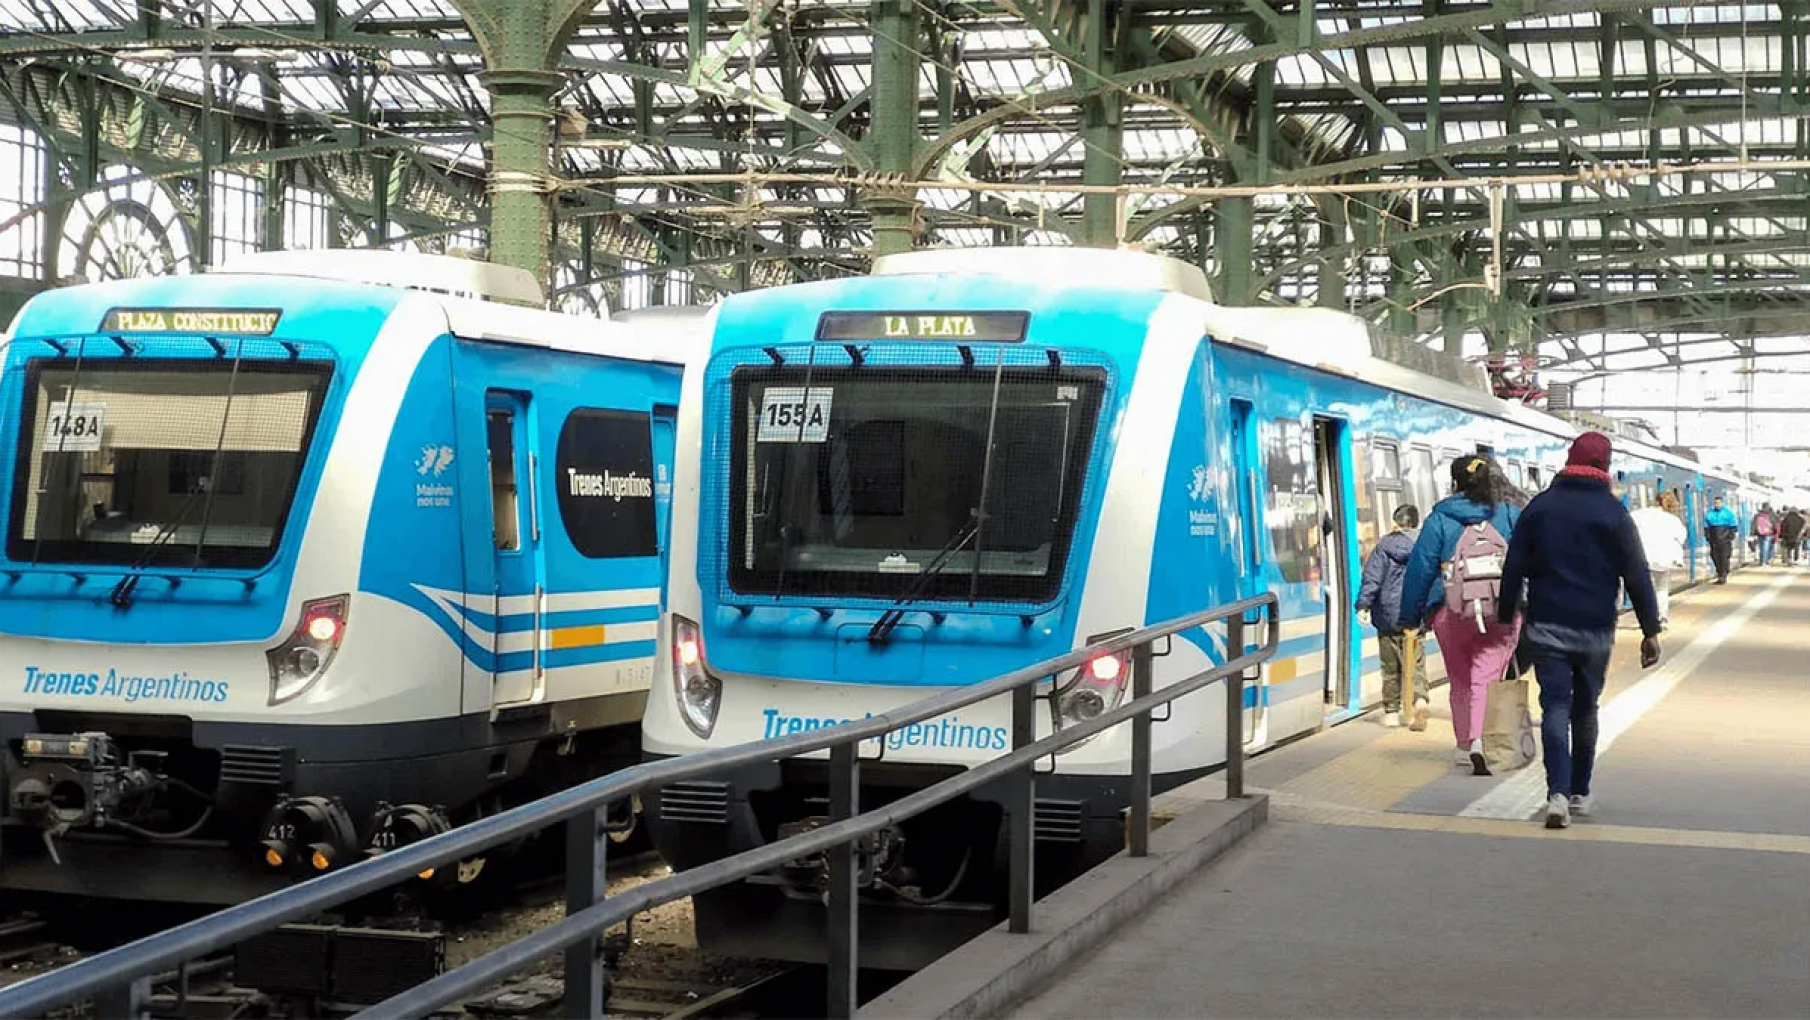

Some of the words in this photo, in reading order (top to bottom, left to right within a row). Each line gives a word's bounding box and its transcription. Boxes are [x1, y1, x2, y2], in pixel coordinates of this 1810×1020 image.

[117, 312, 167, 331] PLAZA
[884, 315, 909, 336] LA
[918, 315, 976, 336] PLATA
[767, 402, 823, 427] 155A
[52, 415, 98, 436] 148A
[567, 467, 603, 497] Trenes
[604, 469, 652, 503] Argentinos
[23, 666, 99, 696] Trenes
[100, 667, 229, 702] Argentinos
[864, 712, 1008, 750] gentinos
[268, 824, 296, 839] 412
[371, 832, 396, 847] 411
